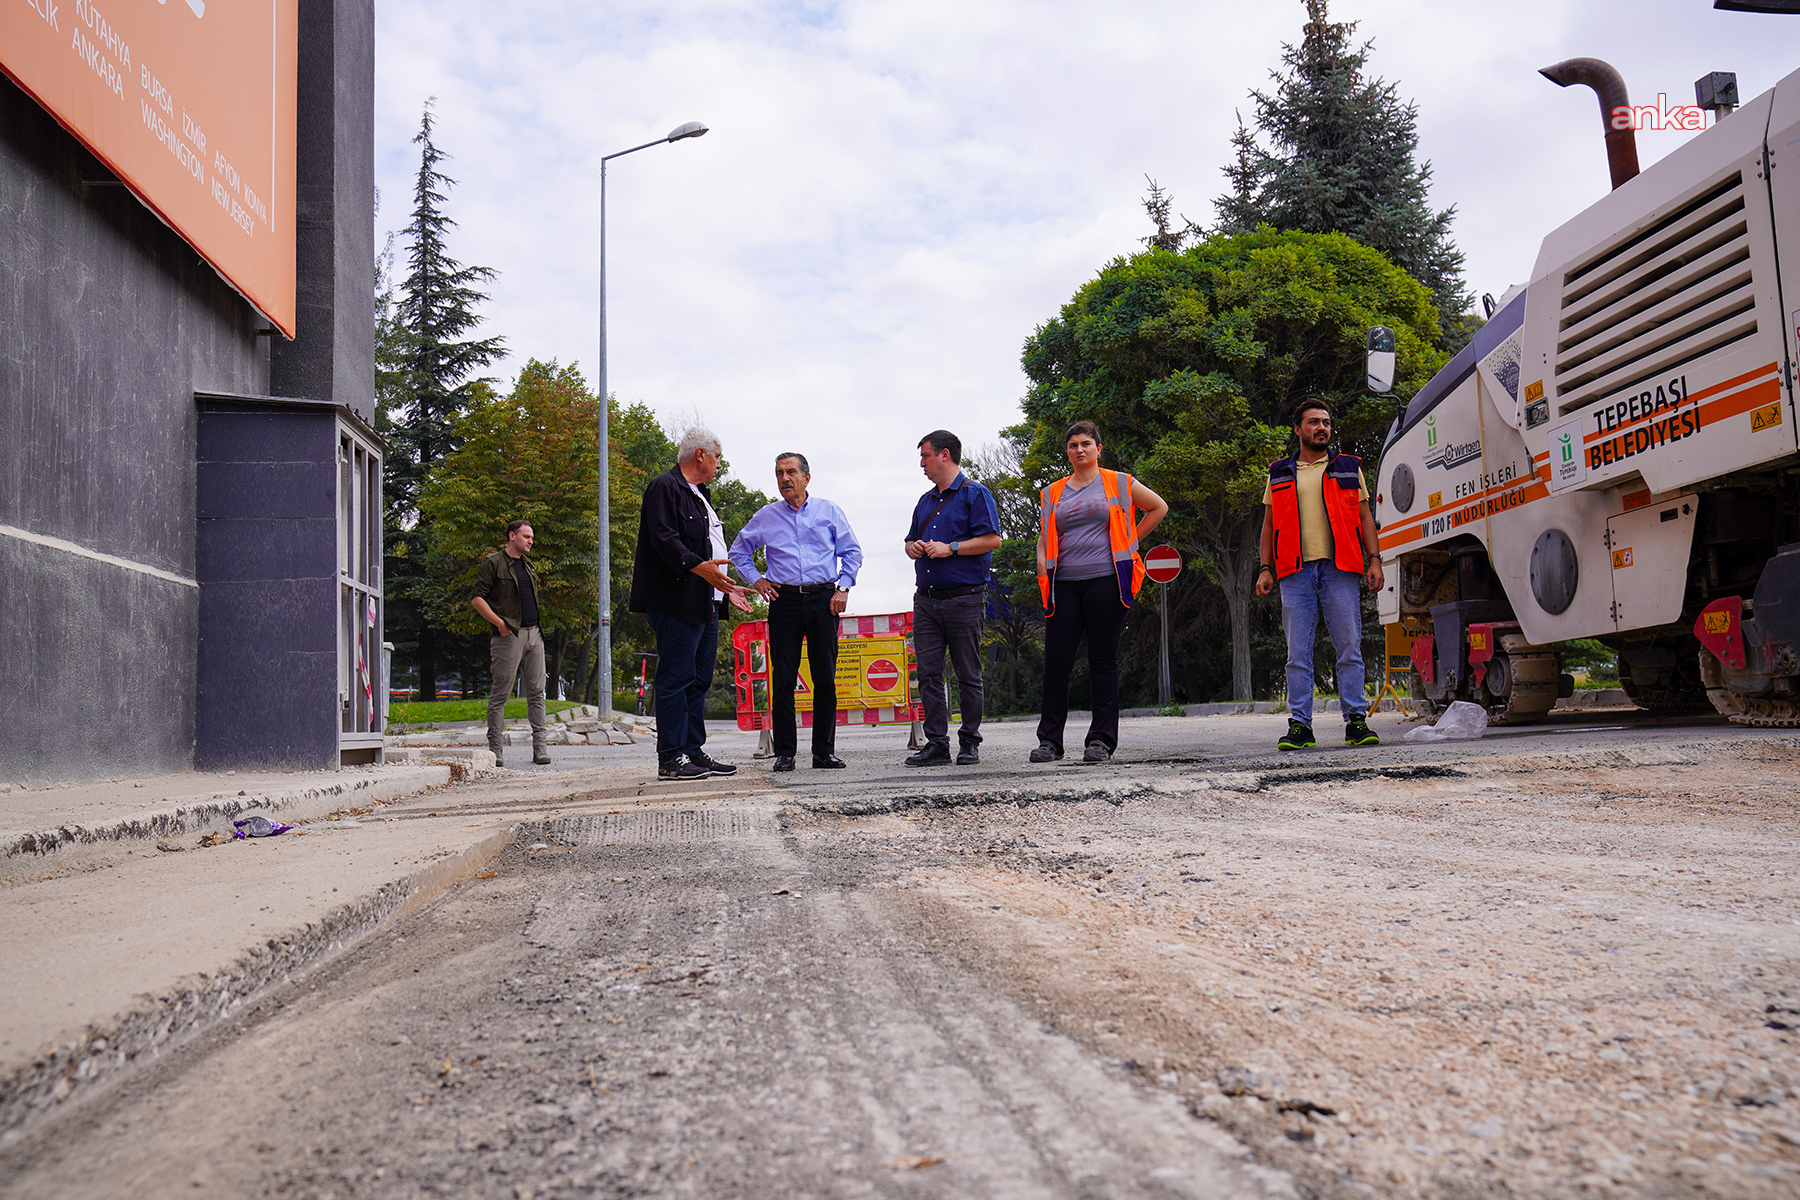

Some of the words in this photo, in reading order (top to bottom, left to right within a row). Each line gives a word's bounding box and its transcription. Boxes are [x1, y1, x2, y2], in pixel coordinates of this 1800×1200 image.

[72, 27, 124, 101] ANKARA
[141, 98, 204, 186] WASHINGTON
[211, 176, 230, 212] NEW
[230, 198, 254, 238] JERSEY
[141, 63, 174, 120] BURSA
[182, 107, 206, 156] İZMİR
[214, 150, 240, 194] AFYON
[244, 183, 267, 225] KONYA
[1593, 375, 1688, 435] TEPEBAŞI
[1454, 440, 1480, 457] Wirtgen
[1590, 400, 1701, 471] BELEDİYESİ
[1455, 480, 1475, 498] FEN
[1479, 461, 1517, 491] İŞLERİ
[1422, 521, 1430, 538] W
[1432, 516, 1445, 536] 120
[1454, 486, 1526, 526] MÜDÜRLÜĞÜ
